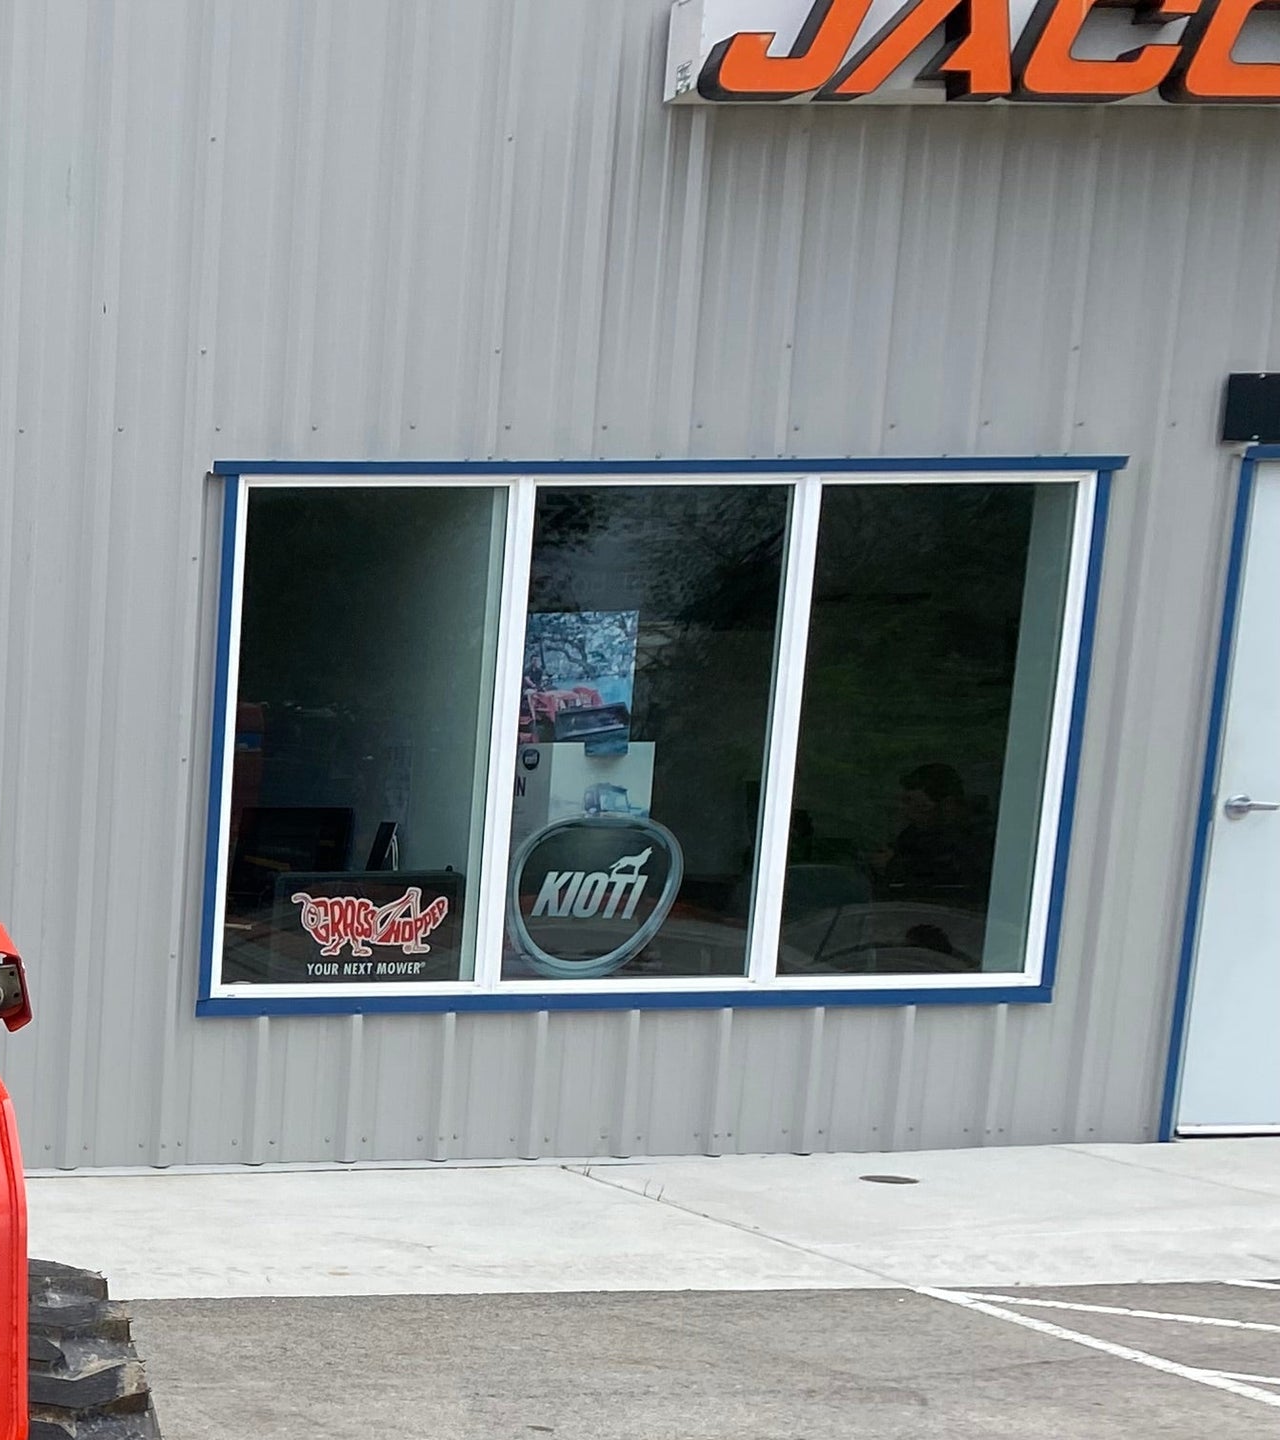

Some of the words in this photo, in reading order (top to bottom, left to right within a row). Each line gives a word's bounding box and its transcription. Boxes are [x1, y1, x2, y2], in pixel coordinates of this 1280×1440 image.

[531, 871, 649, 920] KIOTI
[307, 963, 339, 976] YOUR
[343, 963, 373, 975] NEXT
